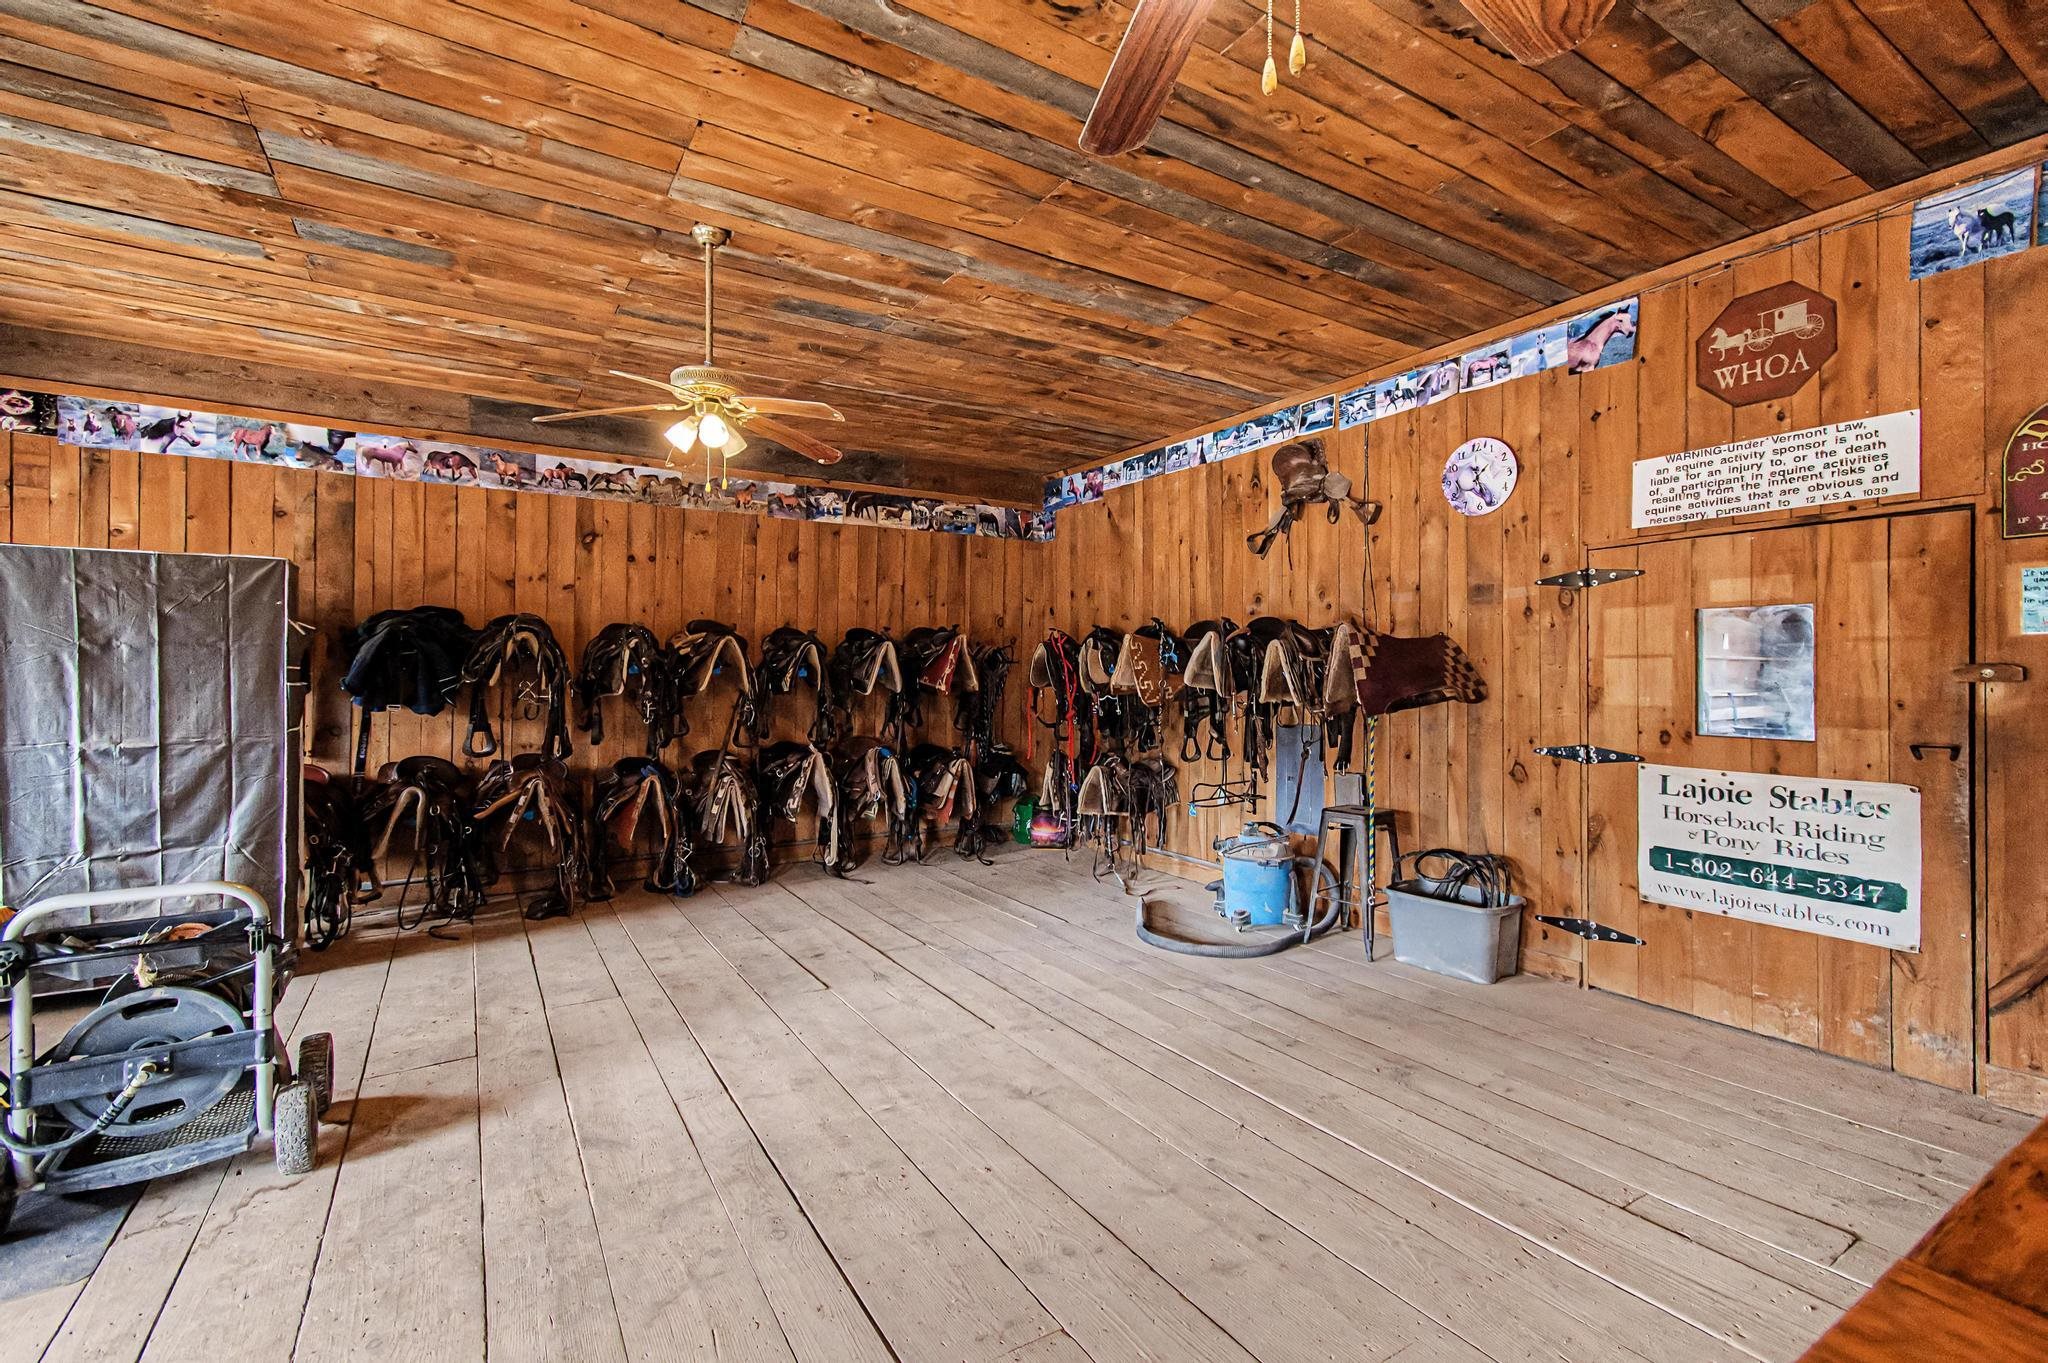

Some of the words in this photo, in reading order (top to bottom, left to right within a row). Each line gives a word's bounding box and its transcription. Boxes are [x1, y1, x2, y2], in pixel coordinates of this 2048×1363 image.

[1712, 348, 1810, 390] WHOA
[1502, 452, 1508, 461] 2
[1656, 468, 1669, 476] an
[1675, 460, 1714, 473] equine
[1720, 451, 1766, 465] activity
[1772, 439, 1826, 456] sponsor
[1835, 436, 1846, 444] is
[1855, 430, 1879, 441] not
[1772, 428, 1828, 444] Vermont
[1507, 467, 1512, 476] 3
[1650, 475, 1679, 487] liable
[1686, 472, 1701, 481] for
[1707, 469, 1721, 477] an
[1728, 462, 1763, 475] injury
[1794, 454, 1808, 463] or
[1815, 449, 1837, 460] the
[1845, 441, 1886, 455] death
[1652, 491, 1700, 505] resulting
[1707, 486, 1734, 496] from
[1741, 481, 1761, 491] the
[1768, 471, 1823, 488] inherent
[1831, 464, 1865, 478] risks
[1874, 461, 1890, 472] of
[1681, 475, 1745, 493] participant
[1751, 472, 1763, 481] in
[1770, 464, 1815, 479] equine
[1823, 452, 1889, 470] activities
[1463, 501, 1467, 509] 7
[1477, 502, 1482, 510] 6
[1502, 482, 1508, 491] 4
[1645, 504, 1682, 516] equine
[1688, 494, 1741, 509] activities
[1748, 490, 1773, 500] that
[1780, 487, 1800, 496] are
[1808, 477, 1863, 493] obvious
[1871, 472, 1899, 484] and
[1716, 501, 1771, 517] pursuant
[1778, 499, 1790, 508] to
[1806, 496, 1816, 504] 12
[1822, 491, 1856, 502] V.S.A.
[1863, 487, 1888, 496] 1039
[1658, 774, 1753, 805] Lajoie
[1769, 785, 1892, 820] Stables
[1662, 804, 1785, 835] Horseback
[1792, 816, 1886, 852] Riding
[1702, 829, 1760, 855] Pony
[1773, 839, 1850, 865] Rides
[1664, 853, 1884, 904] 1-802-644-5347
[1657, 883, 1891, 937] www.lajoiestables.com
